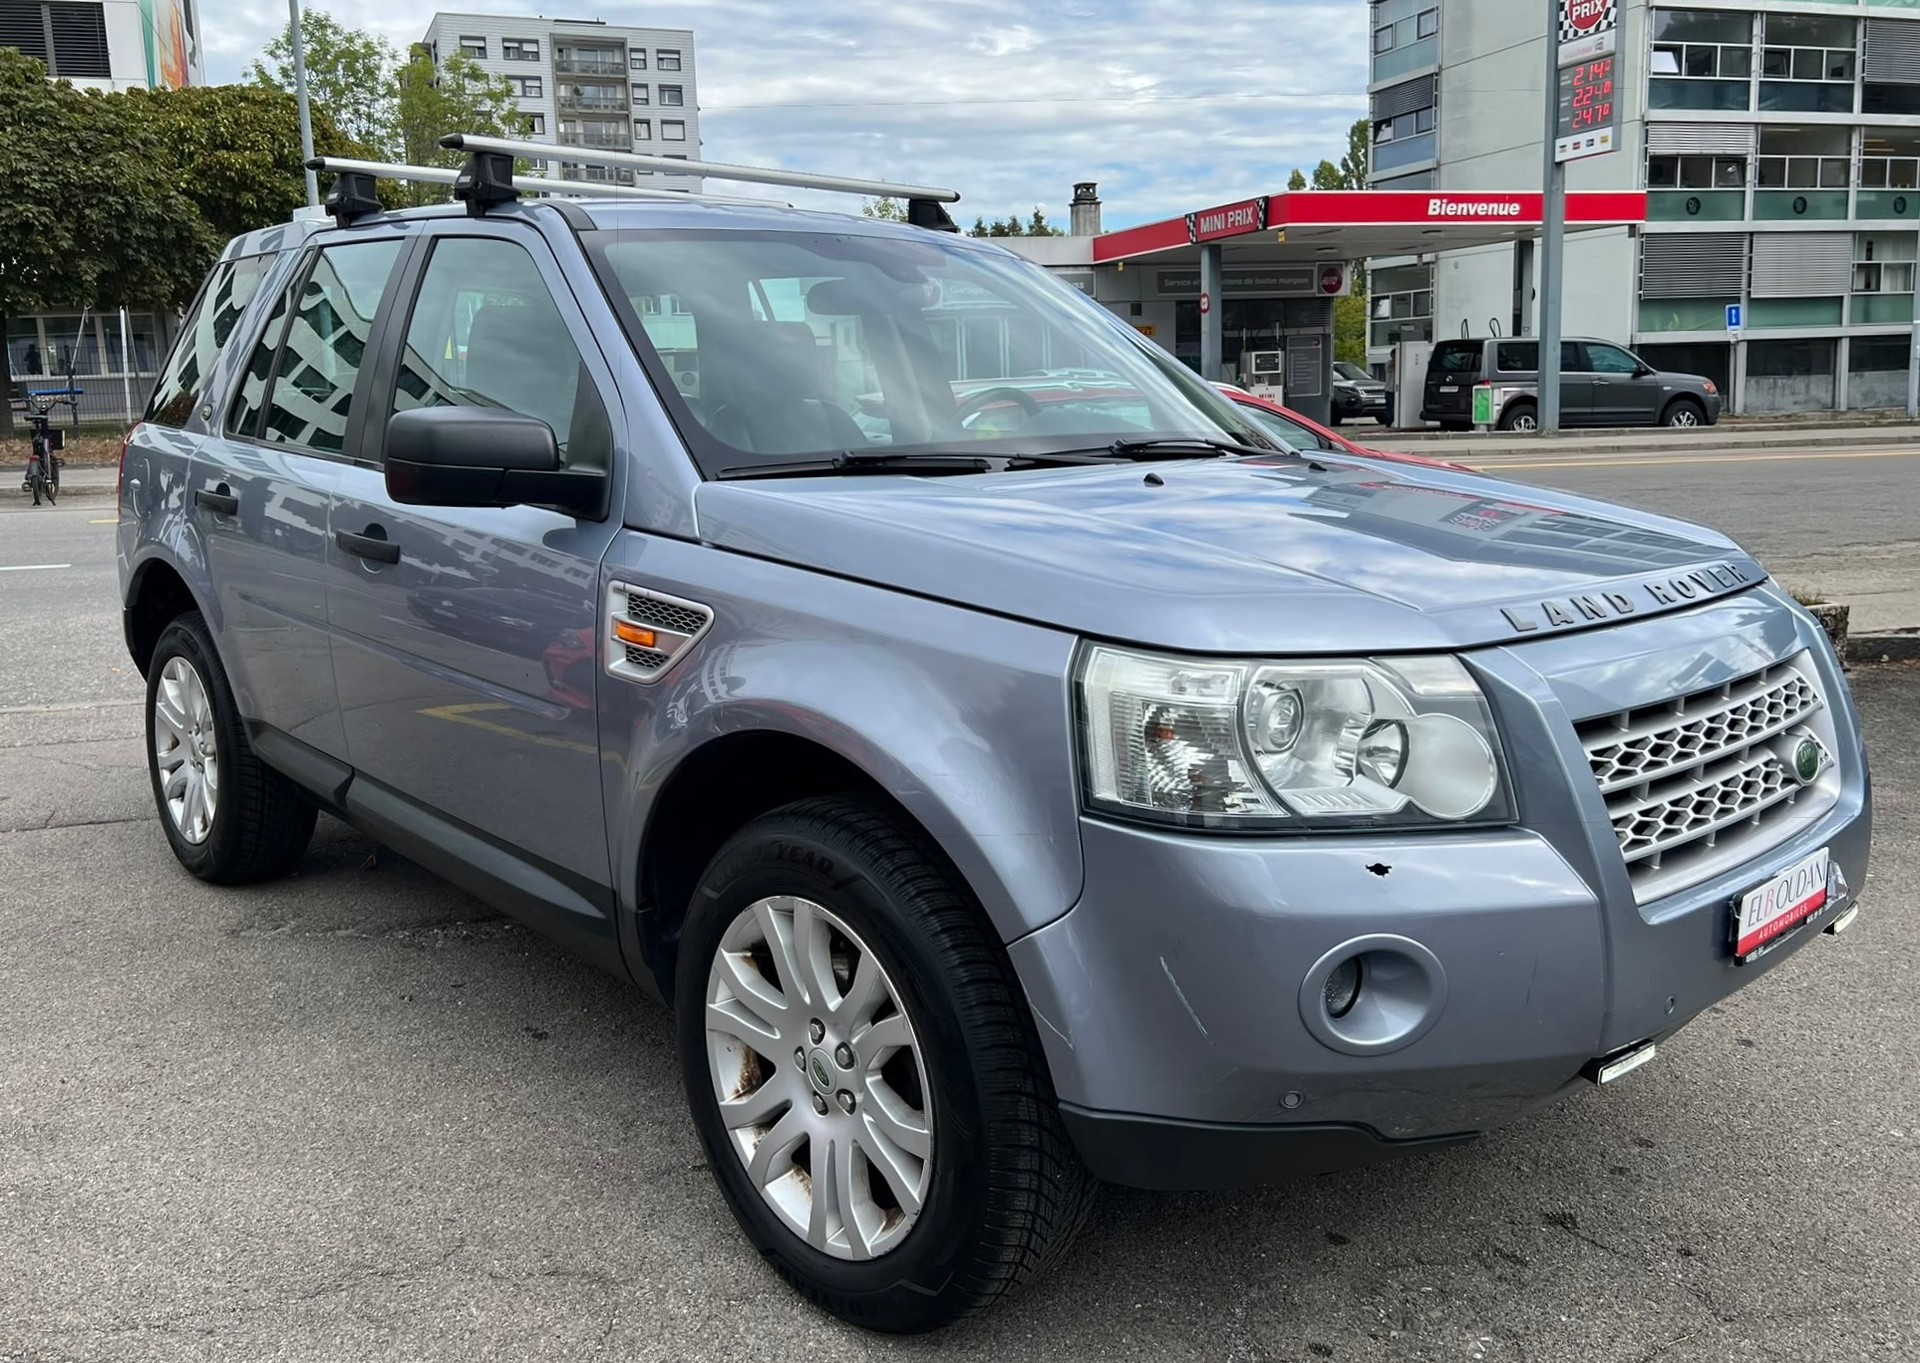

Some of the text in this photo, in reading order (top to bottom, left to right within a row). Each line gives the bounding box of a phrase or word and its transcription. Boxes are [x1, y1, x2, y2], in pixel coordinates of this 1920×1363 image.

[1572, 0, 1604, 21] PRIX
[1427, 199, 1520, 216] Bienvenue
[1200, 207, 1254, 234] MINI PRIX
[1164, 278, 1192, 287] Service
[1500, 563, 1749, 632] LAND ROVER
[1759, 903, 1808, 940] AUTOMOBILES
